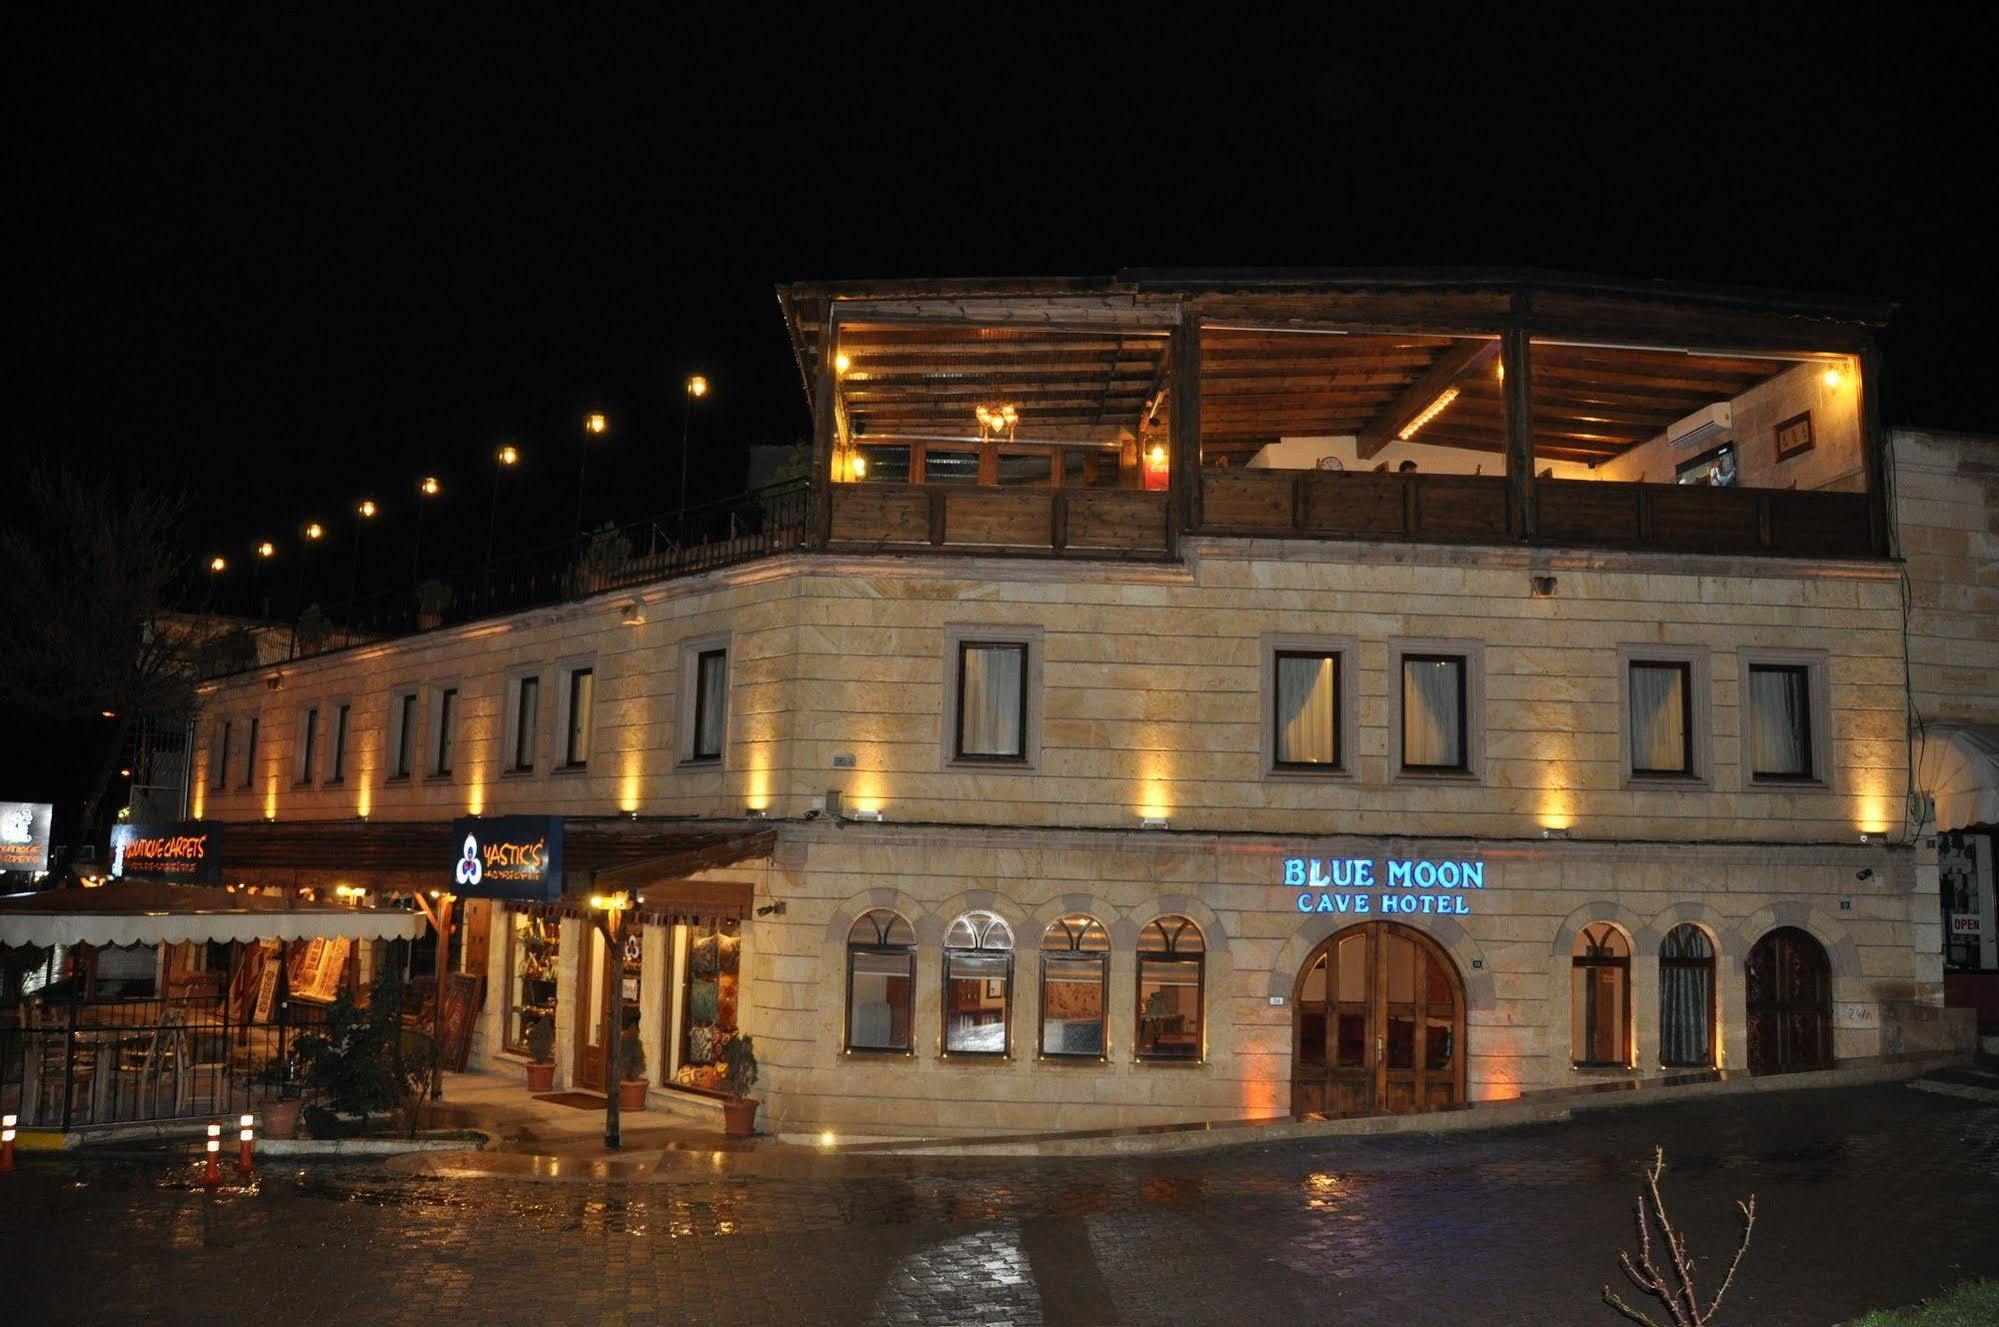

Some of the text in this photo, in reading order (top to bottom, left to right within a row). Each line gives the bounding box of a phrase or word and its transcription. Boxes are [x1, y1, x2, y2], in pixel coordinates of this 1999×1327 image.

[164, 834, 206, 859] CARPETS
[1283, 857, 1485, 889] BLUE MOON
[1297, 893, 1471, 915] CAVE HOTEL
[1953, 918, 1981, 931] OPEN
